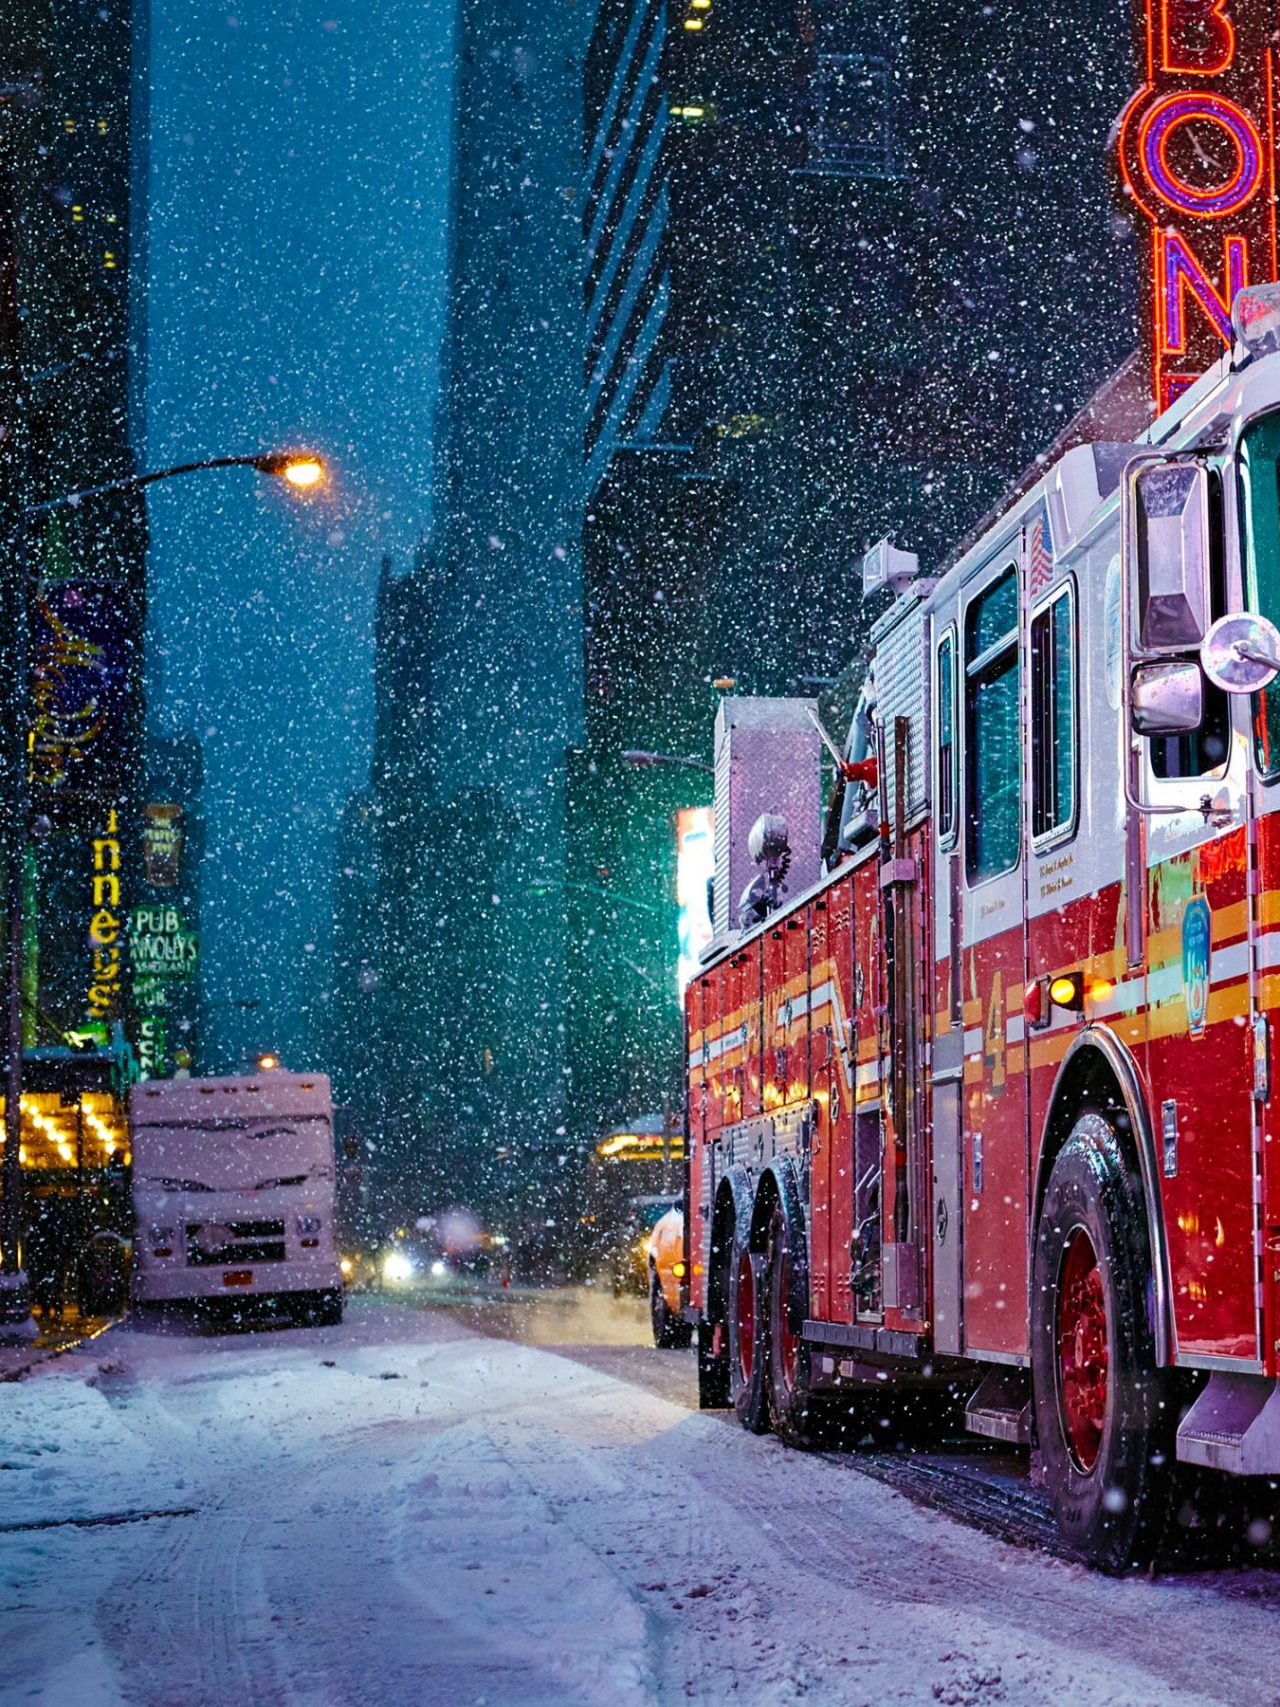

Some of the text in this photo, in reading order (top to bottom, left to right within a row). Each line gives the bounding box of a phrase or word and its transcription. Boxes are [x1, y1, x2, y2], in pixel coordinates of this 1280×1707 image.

[1140, 0, 1263, 407] BON
[136, 910, 180, 934] PUB
[984, 969, 1006, 1090] 4
